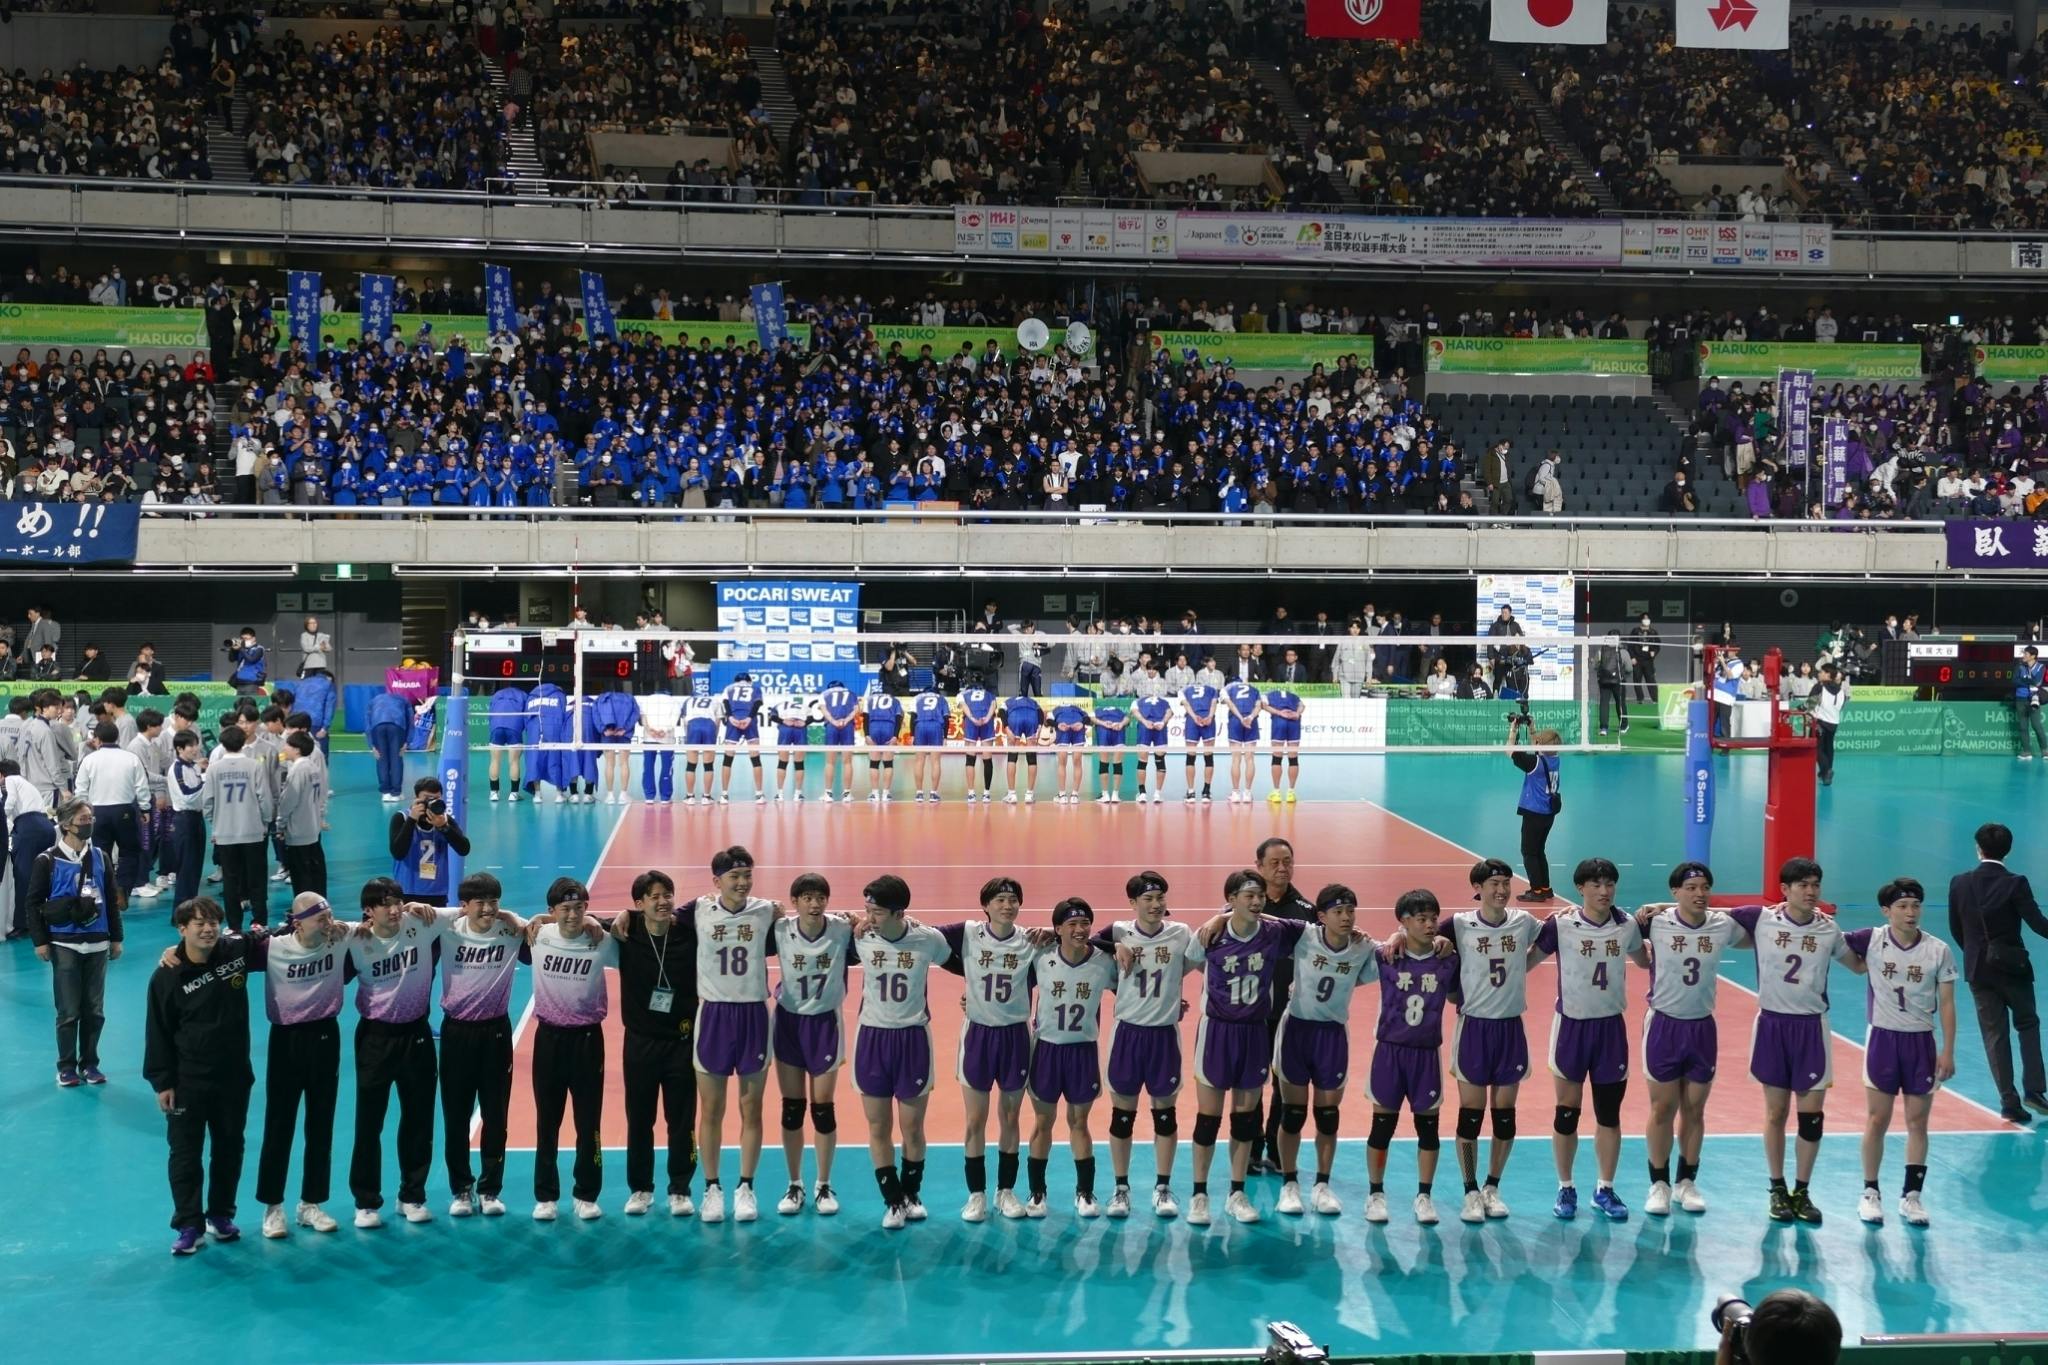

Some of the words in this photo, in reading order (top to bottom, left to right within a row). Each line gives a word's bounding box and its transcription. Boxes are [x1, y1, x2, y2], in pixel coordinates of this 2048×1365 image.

[1191, 230, 1222, 239] Japanet
[1324, 231, 1407, 242] 全日本バレーボール
[1686, 227, 1709, 235] OHK
[1324, 241, 1407, 253] 高等学校選手権大会
[1744, 248, 1768, 256] UMK
[2018, 243, 2043, 267] 南
[129, 332, 195, 345] HARUKO
[876, 327, 936, 339] HARUKO
[1164, 335, 1223, 346] HARUKO
[1445, 340, 1504, 351] HARUKO
[1711, 344, 1769, 355] HARUKO
[1988, 348, 2046, 359] HARUKO
[1591, 360, 1649, 373] HARUKO
[1857, 366, 1915, 377] HARUKO
[724, 588, 788, 601] POCARI
[791, 588, 853, 602] SWEAT
[1915, 647, 1953, 655] 札幌大谷
[502, 660, 514, 675] 0
[522, 664, 528, 672] 0
[618, 660, 629, 675] 0
[1940, 666, 1950, 682] 0
[750, 673, 823, 687] POCARI
[732, 686, 753, 701] 13
[831, 692, 850, 707] 11
[970, 689, 985, 701] 8
[1191, 686, 1205, 698] 3
[1236, 684, 1250, 698] 2
[871, 696, 892, 709] 10
[923, 697, 938, 710] 9
[1445, 709, 1491, 717] VOLLEYBALL
[1874, 729, 1905, 737] SCHOOL
[223, 782, 247, 802] 77
[446, 781, 456, 819] Seno
[1697, 781, 1707, 823] Senoh
[419, 839, 436, 864] 2
[711, 924, 754, 942] 昇陽
[1775, 931, 1817, 953] 昇陽
[1476, 935, 1517, 954] 昇陽
[1580, 939, 1621, 957] 昇陽
[1670, 935, 1713, 953] 昇陽
[372, 947, 419, 977] SHOYO
[455, 944, 505, 963] SHOYO
[716, 946, 748, 976] 18
[792, 953, 832, 970] 昇陽
[872, 951, 913, 969] 昇陽
[978, 950, 1019, 970] 昇陽
[1131, 946, 1171, 965] 昇陽
[287, 953, 333, 978] SHOYO
[543, 955, 593, 975] SHOYO
[1312, 953, 1352, 975] 昇陽
[1489, 959, 1506, 987] 5
[1682, 957, 1700, 986] 3
[1783, 954, 1802, 984] 2
[1882, 962, 1924, 983] 昇陽
[182, 972, 214, 994] MOVE
[215, 956, 247, 976] SPORT
[1136, 969, 1163, 998] 11
[1396, 972, 1439, 994] 昇陽
[1592, 962, 1608, 990] 4
[796, 974, 828, 1000] 17
[875, 973, 908, 1003] 16
[982, 973, 1012, 1003] 15
[1051, 981, 1092, 1000] 昇陽
[1227, 975, 1259, 1005] 10
[1316, 976, 1334, 1002] 9
[1893, 986, 1906, 1012] 1
[1054, 1003, 1084, 1032] 12
[1405, 994, 1424, 1026] 8
